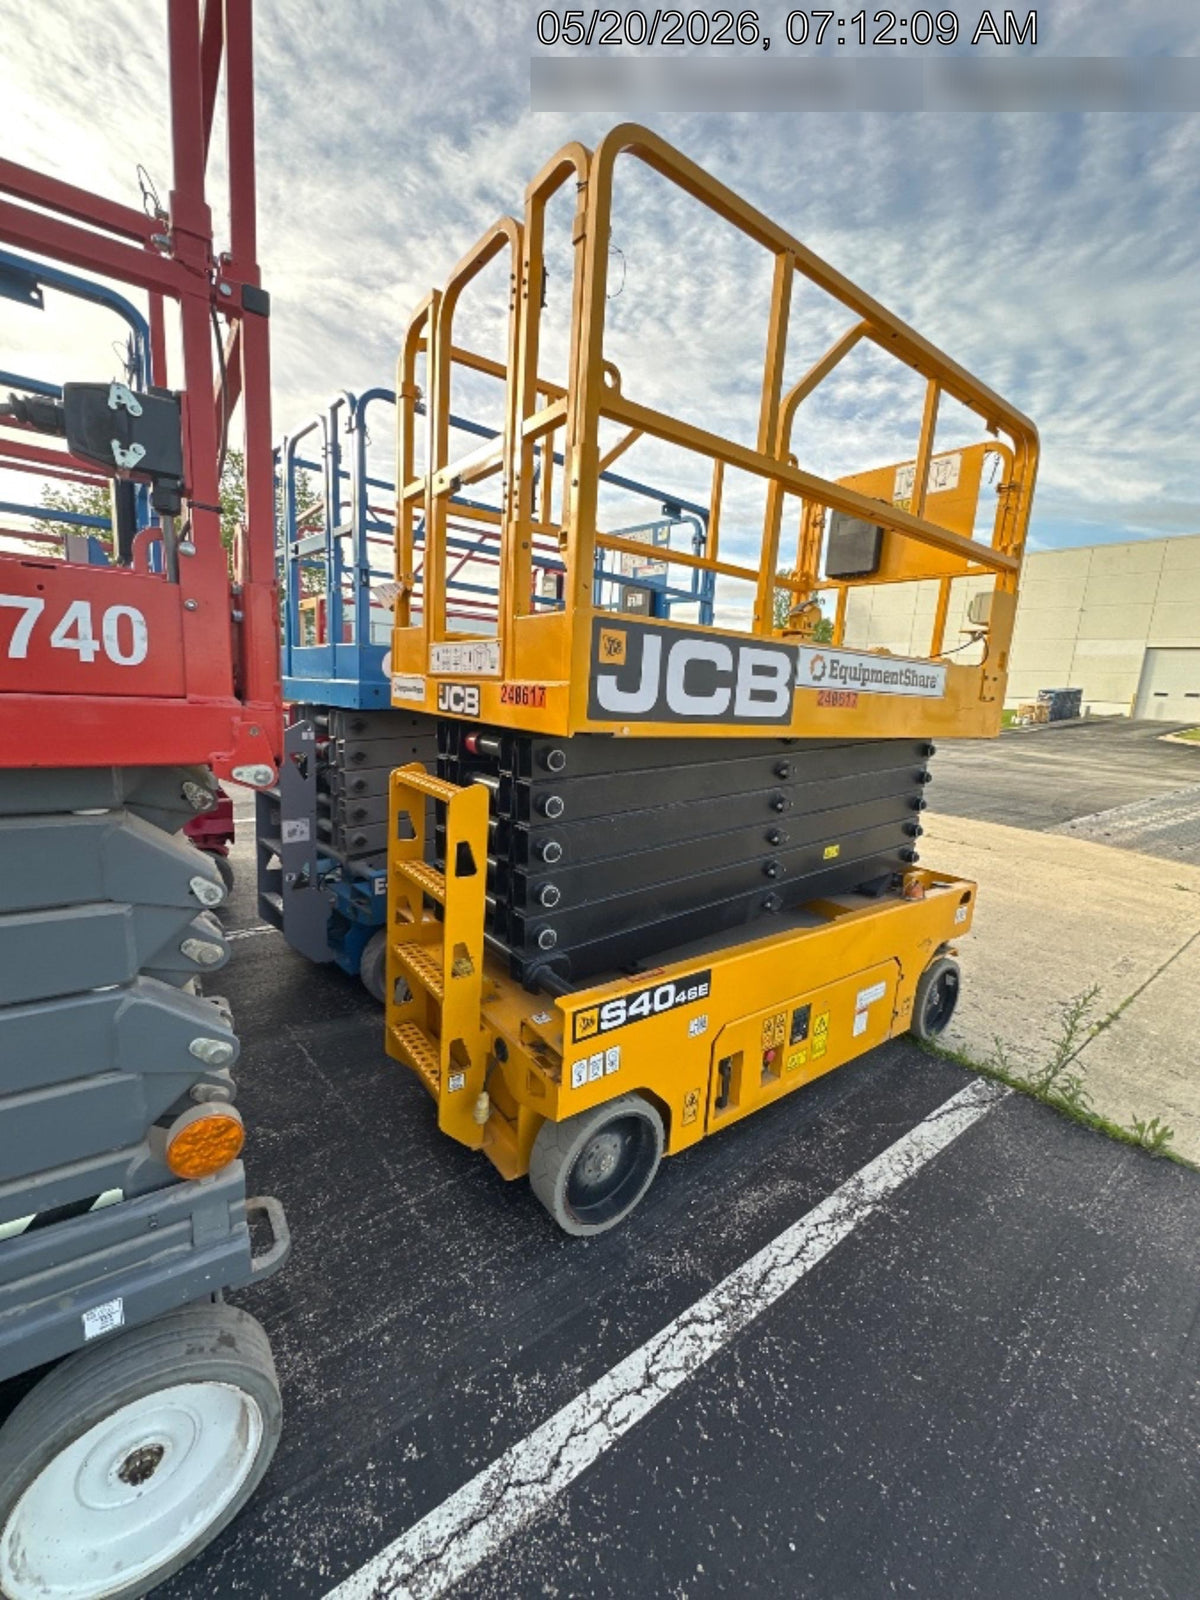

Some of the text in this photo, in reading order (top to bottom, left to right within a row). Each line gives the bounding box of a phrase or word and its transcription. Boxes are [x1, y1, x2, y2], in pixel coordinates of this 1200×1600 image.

[0, 594, 148, 666] 740
[596, 633, 792, 718] JCB
[828, 658, 938, 689] EquipmentShare
[438, 684, 479, 716] JCB
